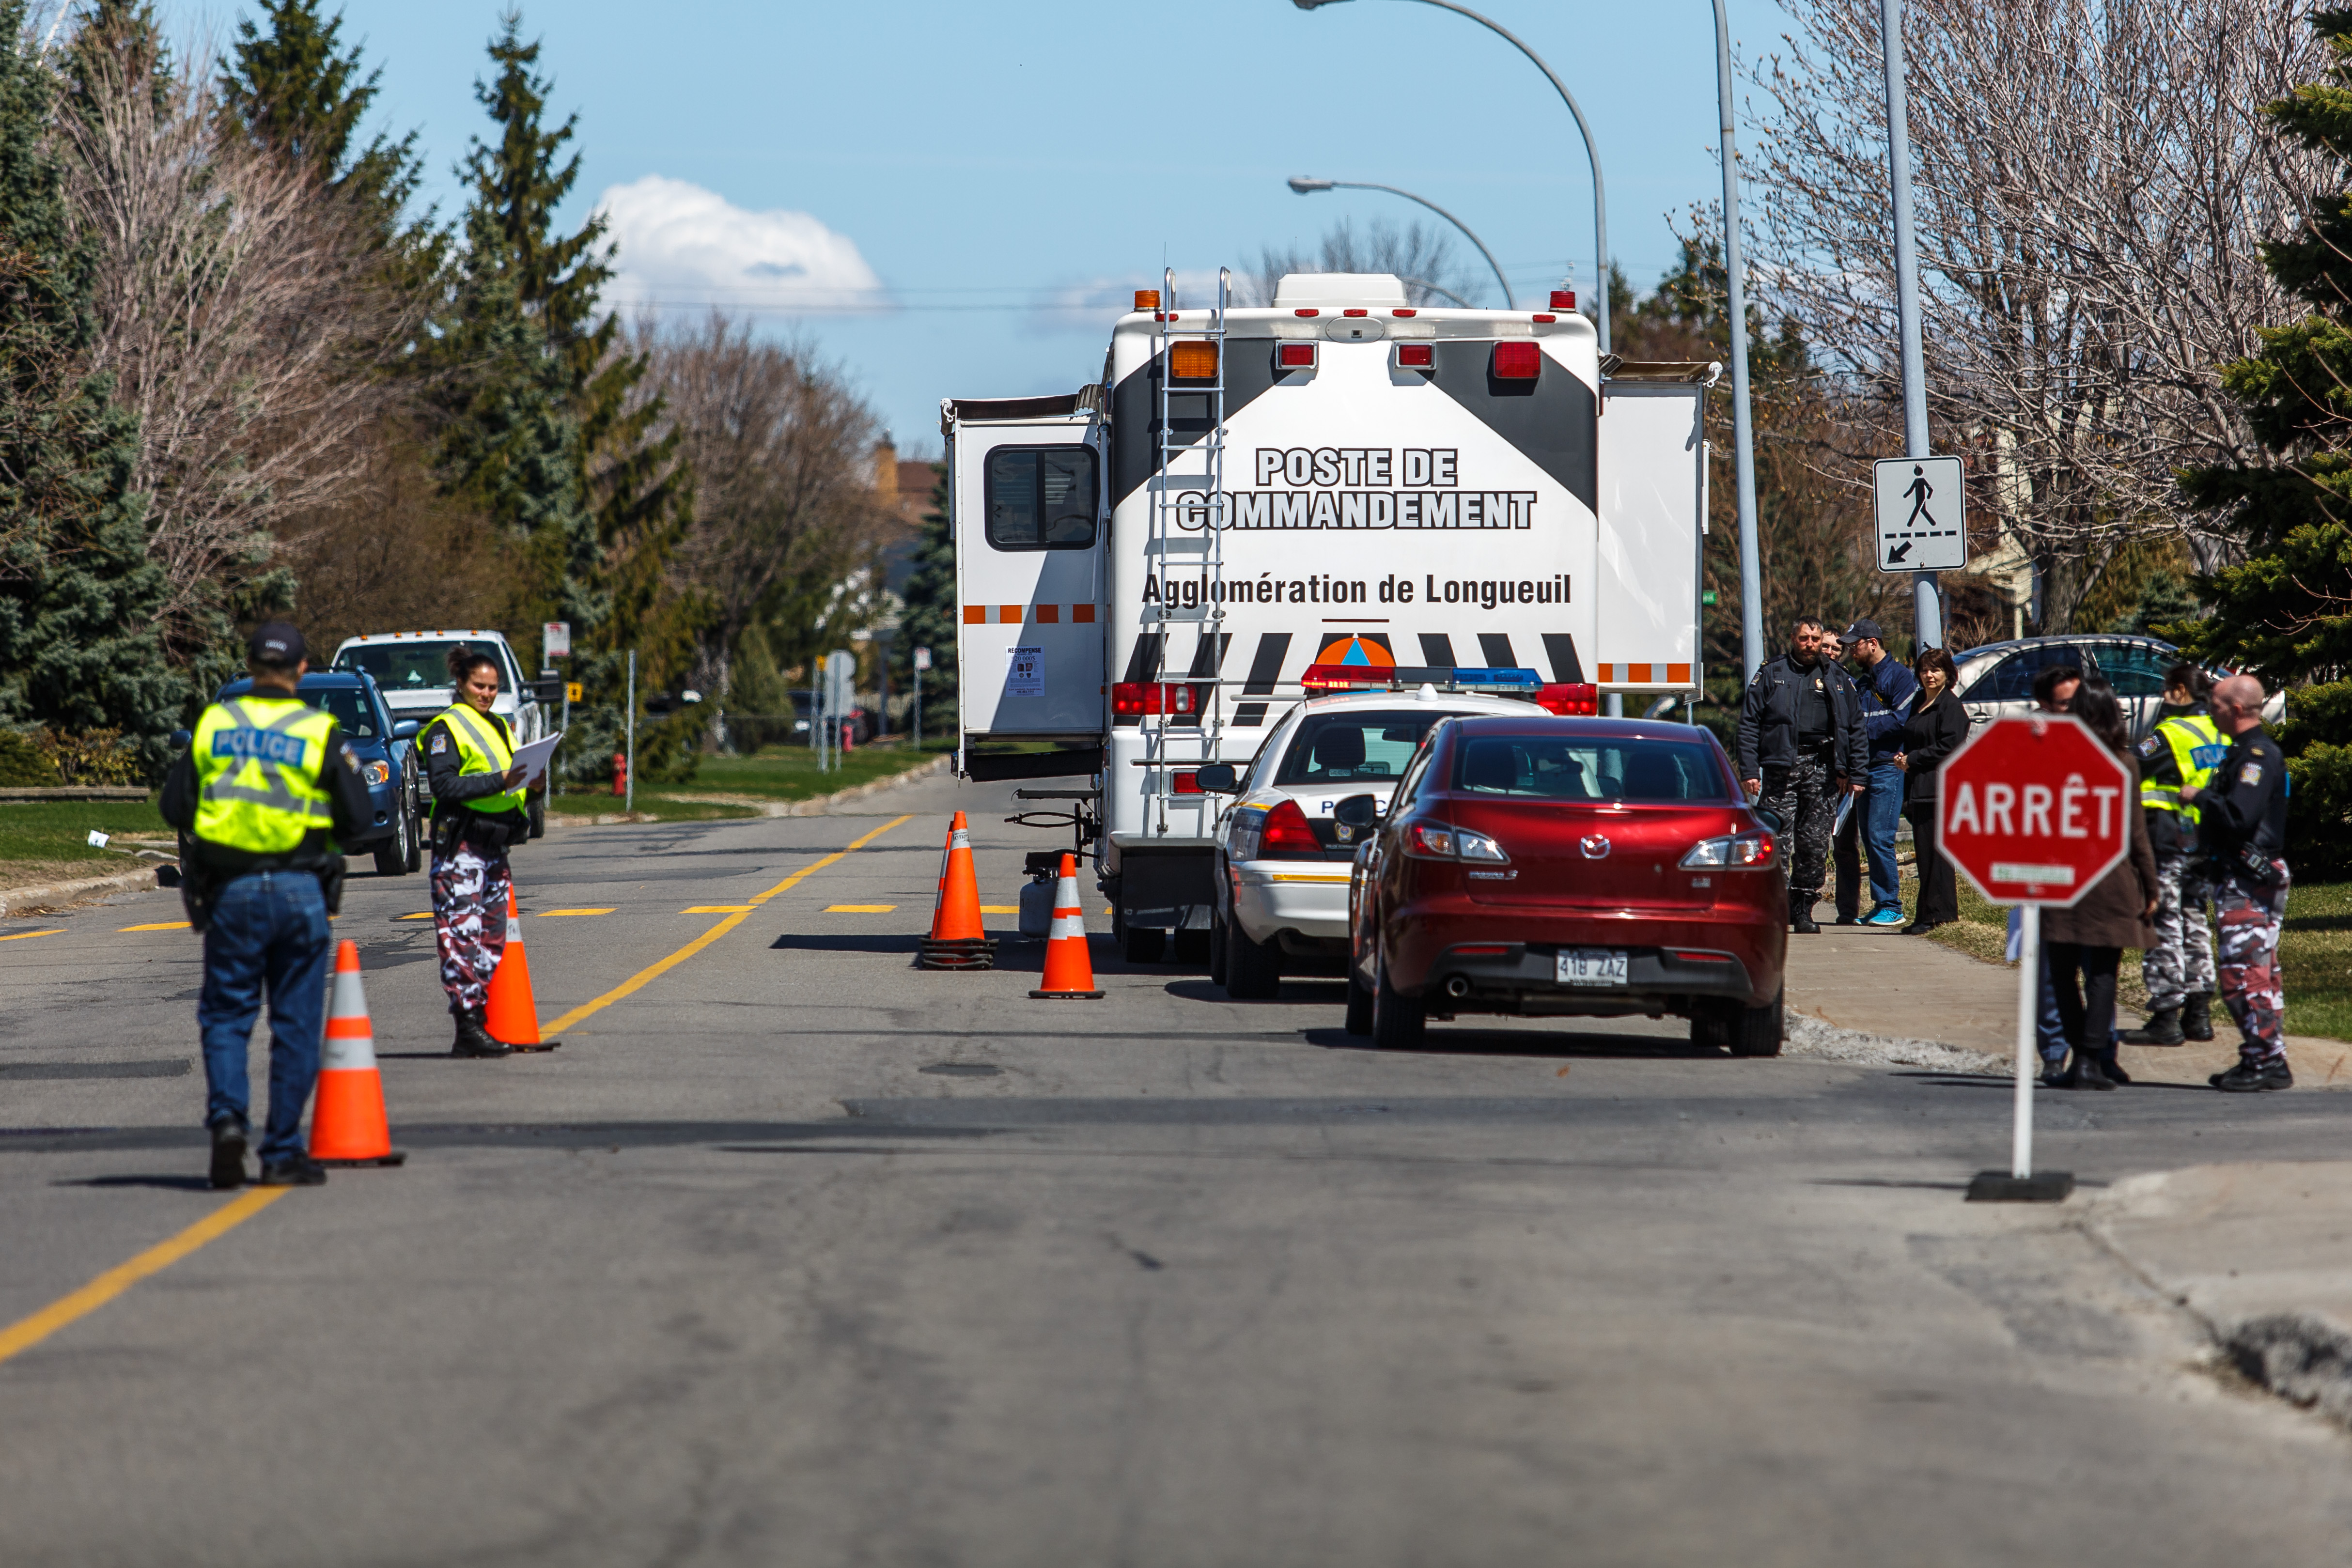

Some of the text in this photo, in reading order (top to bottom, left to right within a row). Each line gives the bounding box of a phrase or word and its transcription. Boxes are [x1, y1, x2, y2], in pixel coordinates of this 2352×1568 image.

[1256, 447, 1458, 487] POSTE DE
[1176, 490, 1537, 530] COMMANDEMENT
[1141, 572, 1571, 609] Agglomération de Longueuil
[216, 730, 301, 763] POLICE
[1948, 772, 2119, 840] ARRÊT
